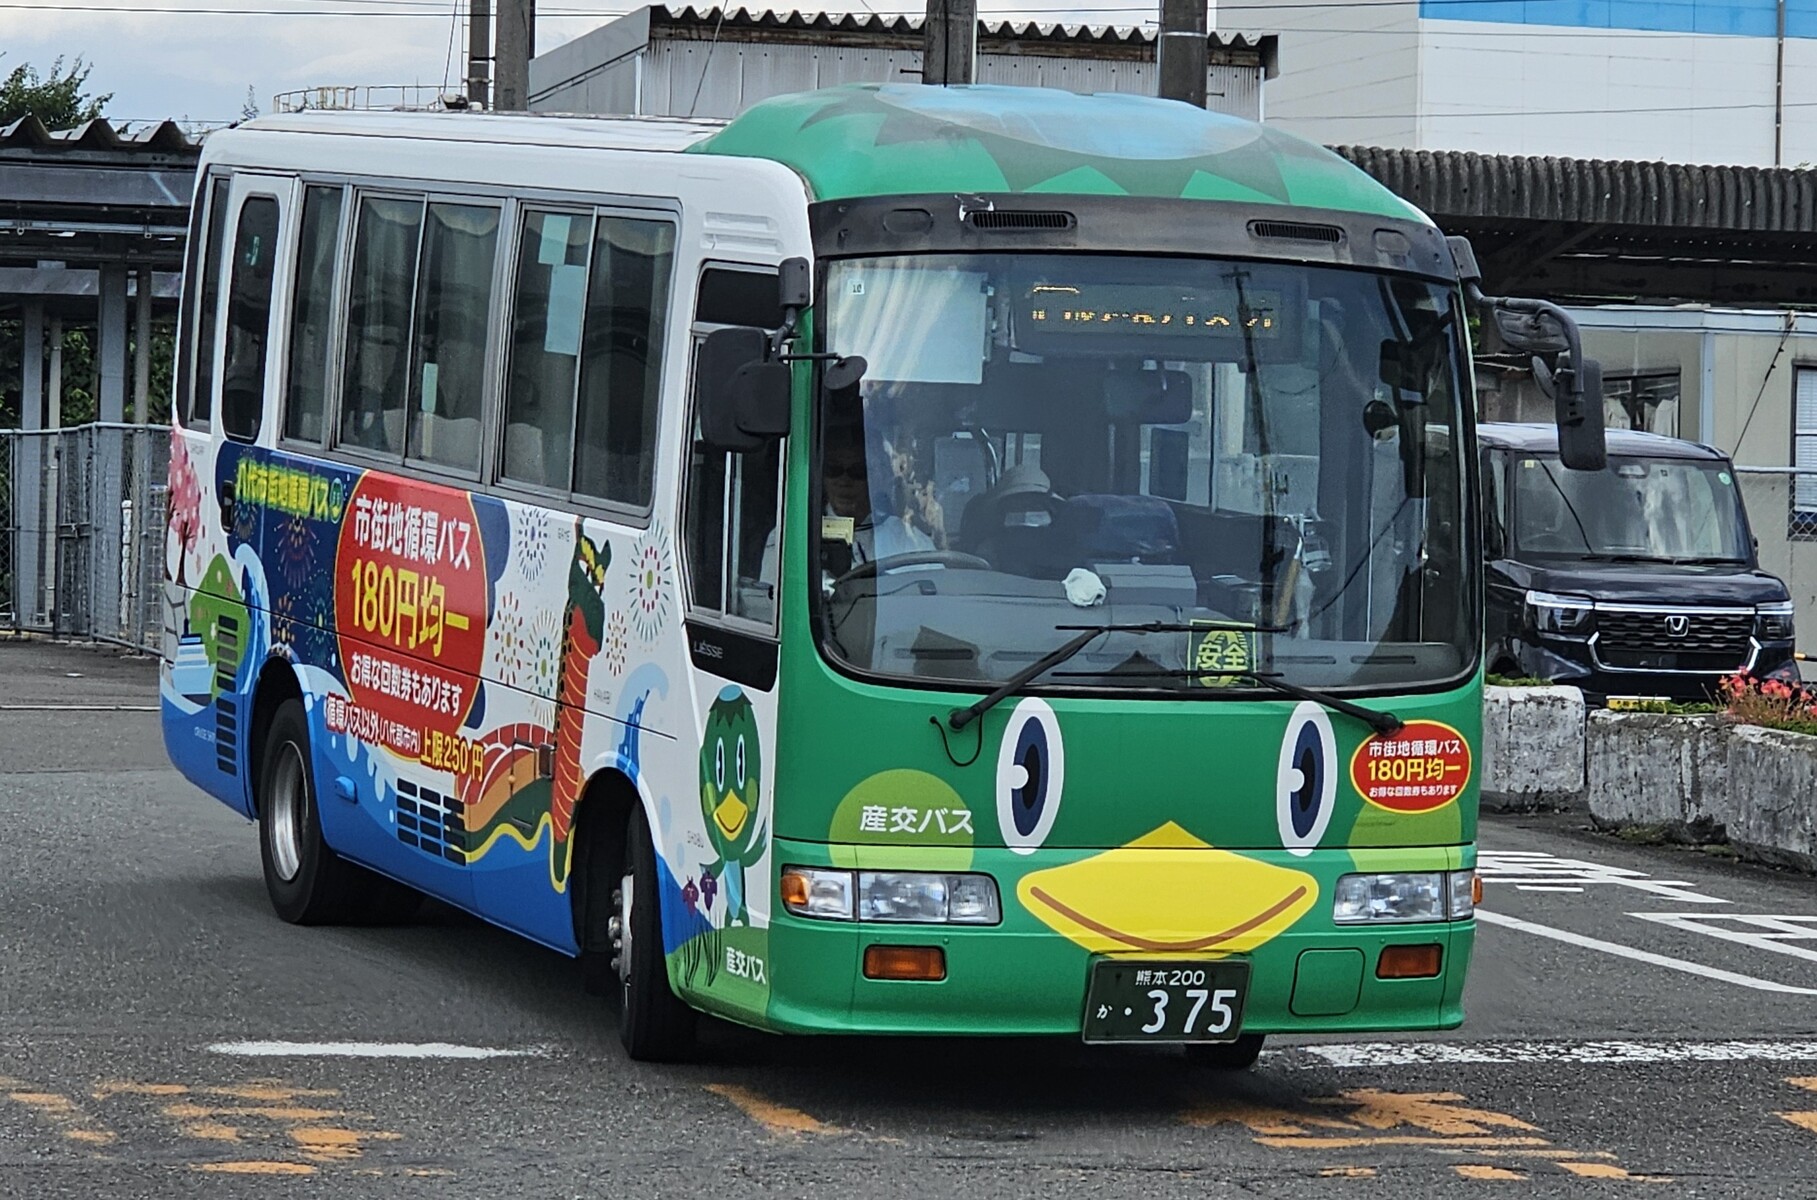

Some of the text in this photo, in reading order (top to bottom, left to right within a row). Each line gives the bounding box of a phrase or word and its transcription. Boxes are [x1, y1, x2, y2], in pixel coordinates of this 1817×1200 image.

[354, 494, 471, 571] 市街地循環バス
[351, 558, 470, 657] 180円均一
[1197, 641, 1249, 671] 安全
[350, 652, 463, 717] お得な回数券もあります
[1368, 739, 1461, 757] 市街地循環バス
[1368, 758, 1461, 782] 180円均一
[1368, 784, 1458, 798] お得な回数券もあります
[859, 804, 975, 835] 産交バス
[725, 946, 767, 985] 産交バス
